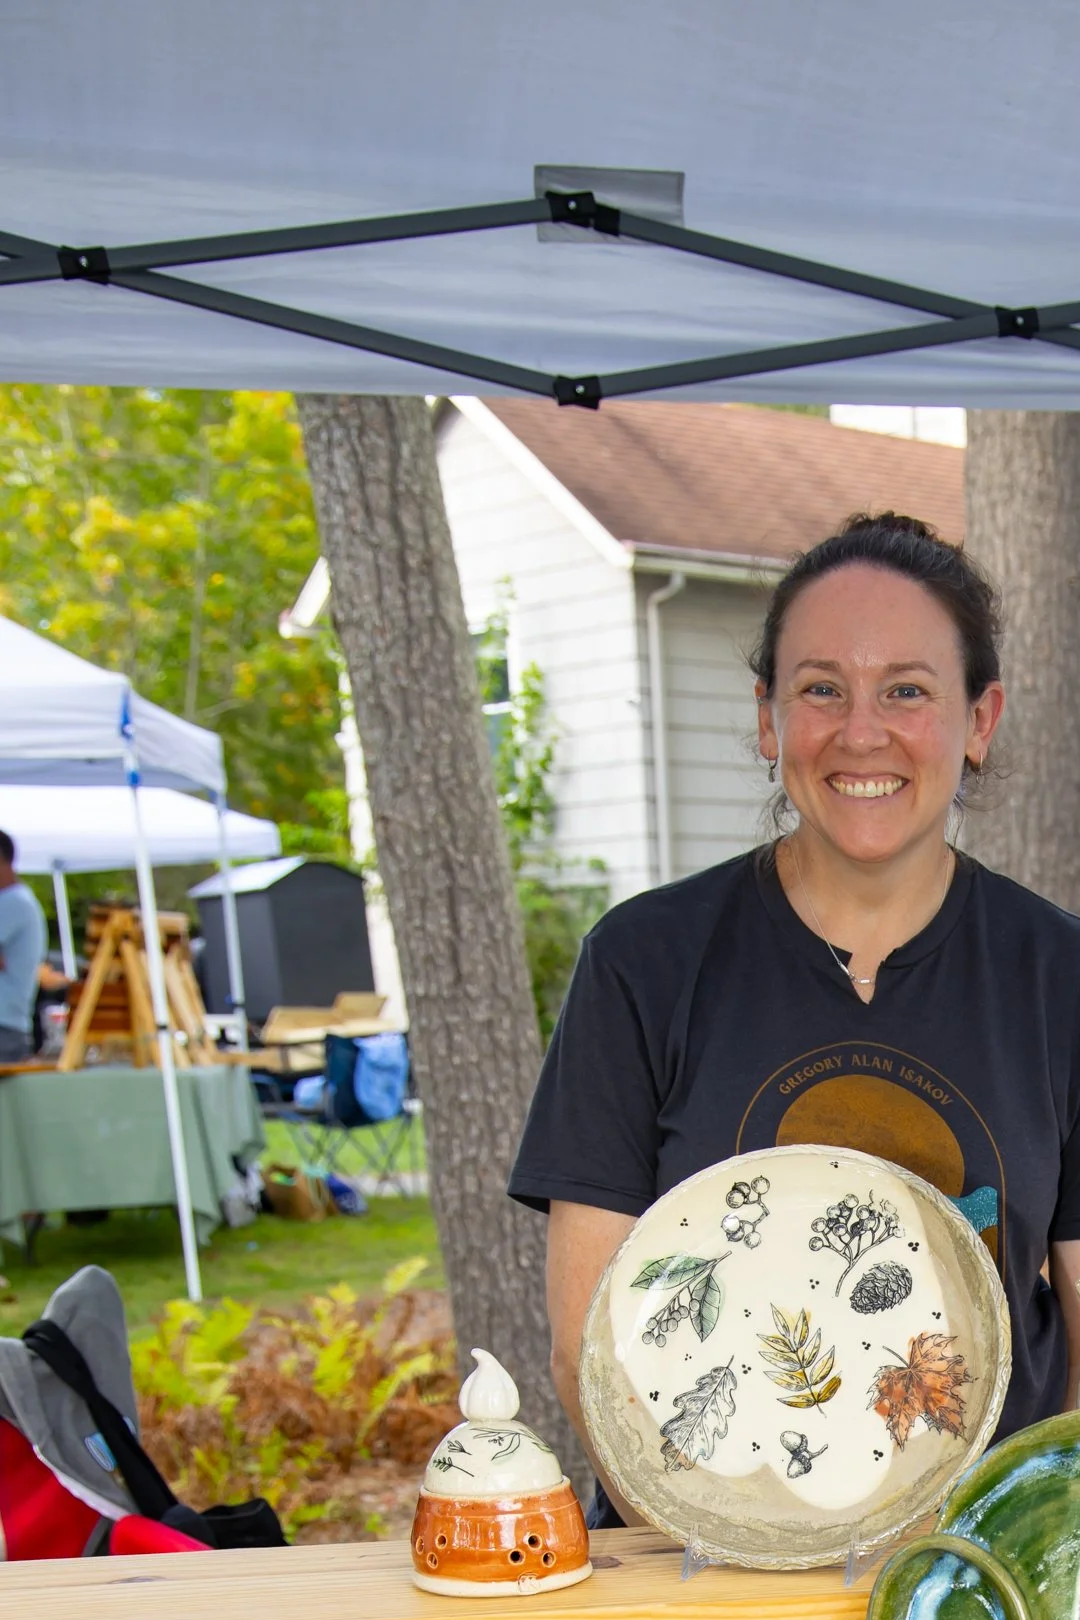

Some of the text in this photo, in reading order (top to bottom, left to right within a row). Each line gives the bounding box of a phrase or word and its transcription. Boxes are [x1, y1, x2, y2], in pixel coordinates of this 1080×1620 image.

[778, 1053, 954, 1106] GREGORY ALAN ISAKOV
